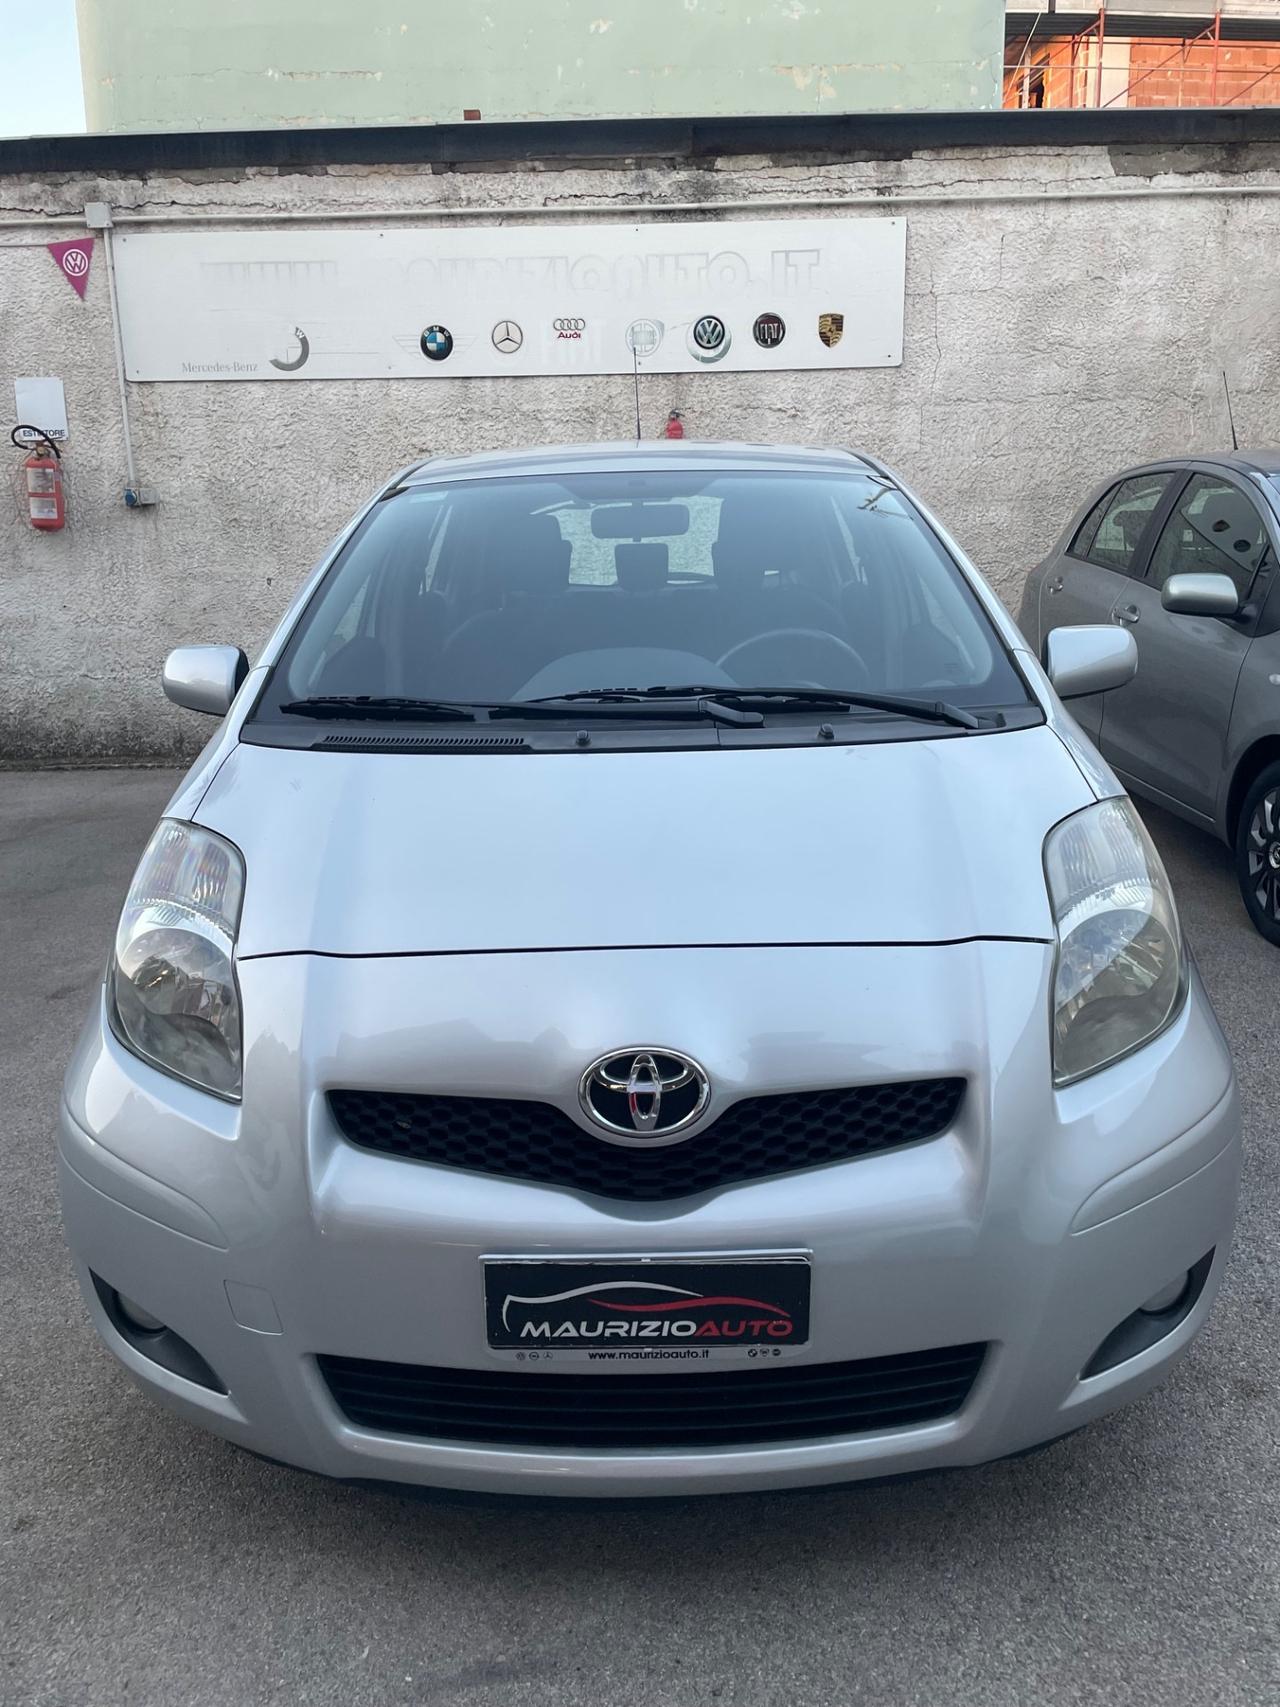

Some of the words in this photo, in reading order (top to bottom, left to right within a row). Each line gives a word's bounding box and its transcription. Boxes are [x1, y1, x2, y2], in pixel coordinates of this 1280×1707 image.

[760, 323, 778, 344] FIAT
[181, 361, 258, 373] Mercedes-Benz
[588, 1348, 710, 1360] www.maurizioauto.it
